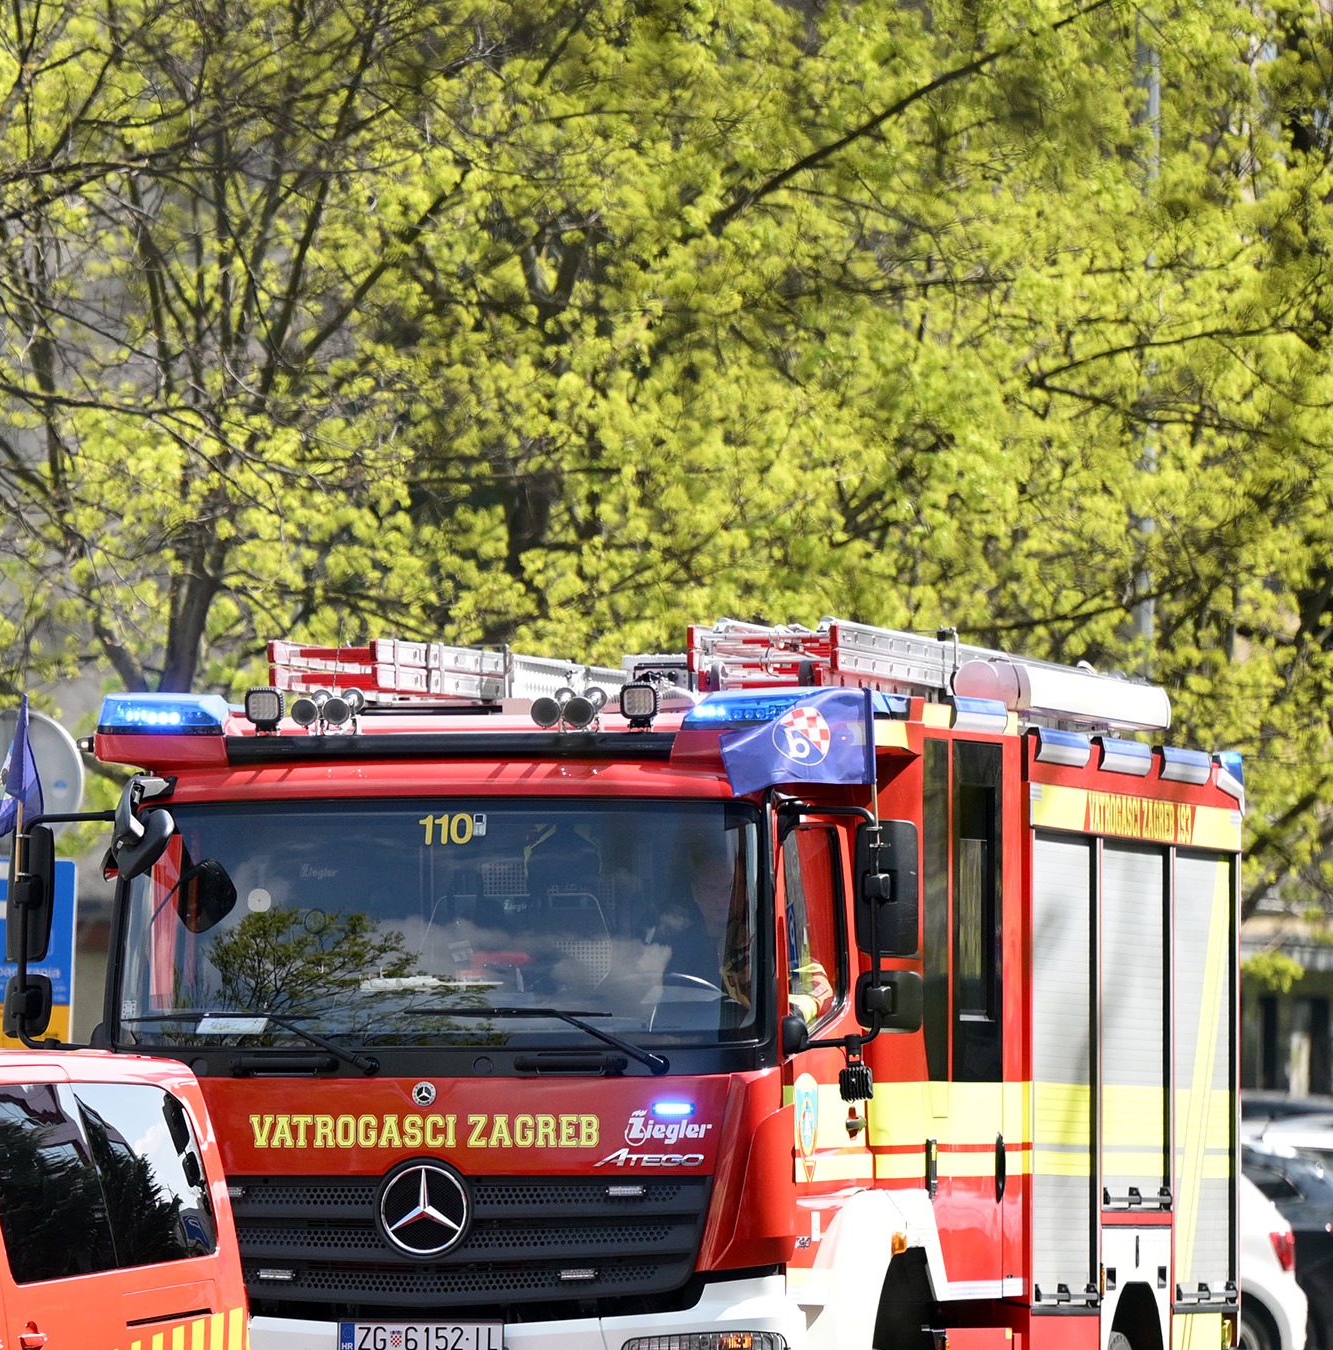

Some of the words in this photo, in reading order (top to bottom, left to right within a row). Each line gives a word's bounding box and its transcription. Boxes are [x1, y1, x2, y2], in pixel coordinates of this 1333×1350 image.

[419, 813, 473, 845] 110
[1088, 790, 1141, 839] VATROGASCI
[1142, 797, 1175, 842] ZAGREB
[1176, 802, 1191, 844] 193
[249, 1113, 457, 1149] VATROGASCI
[466, 1113, 601, 1149] ZAGREB
[624, 1110, 713, 1147] Ziegler
[593, 1148, 705, 1167] ATEGO
[341, 1342, 354, 1350] HR
